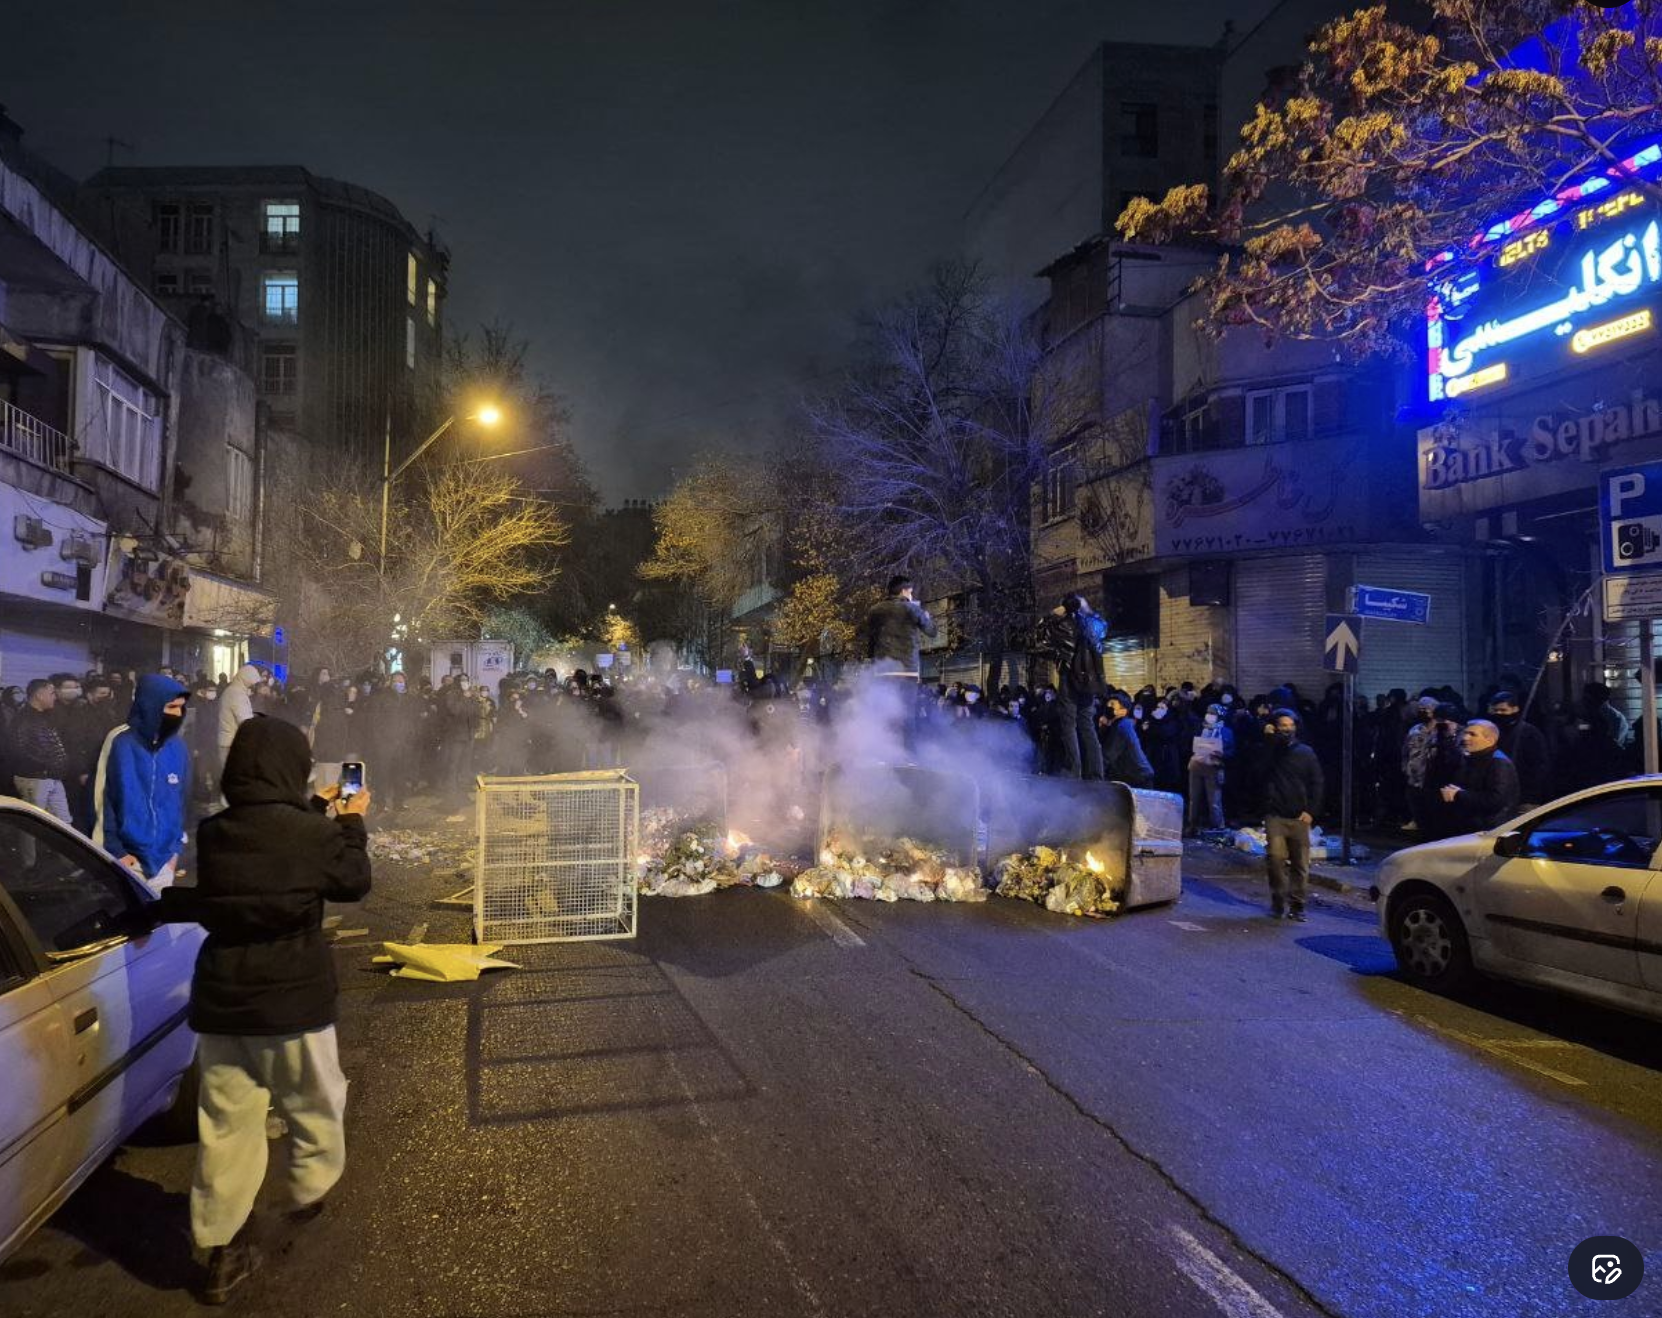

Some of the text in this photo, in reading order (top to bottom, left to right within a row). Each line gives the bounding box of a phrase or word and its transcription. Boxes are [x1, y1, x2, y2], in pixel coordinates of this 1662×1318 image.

[1423, 429, 1514, 490] Bank
[1531, 388, 1662, 463] Sepah
[1609, 473, 1646, 517] P
